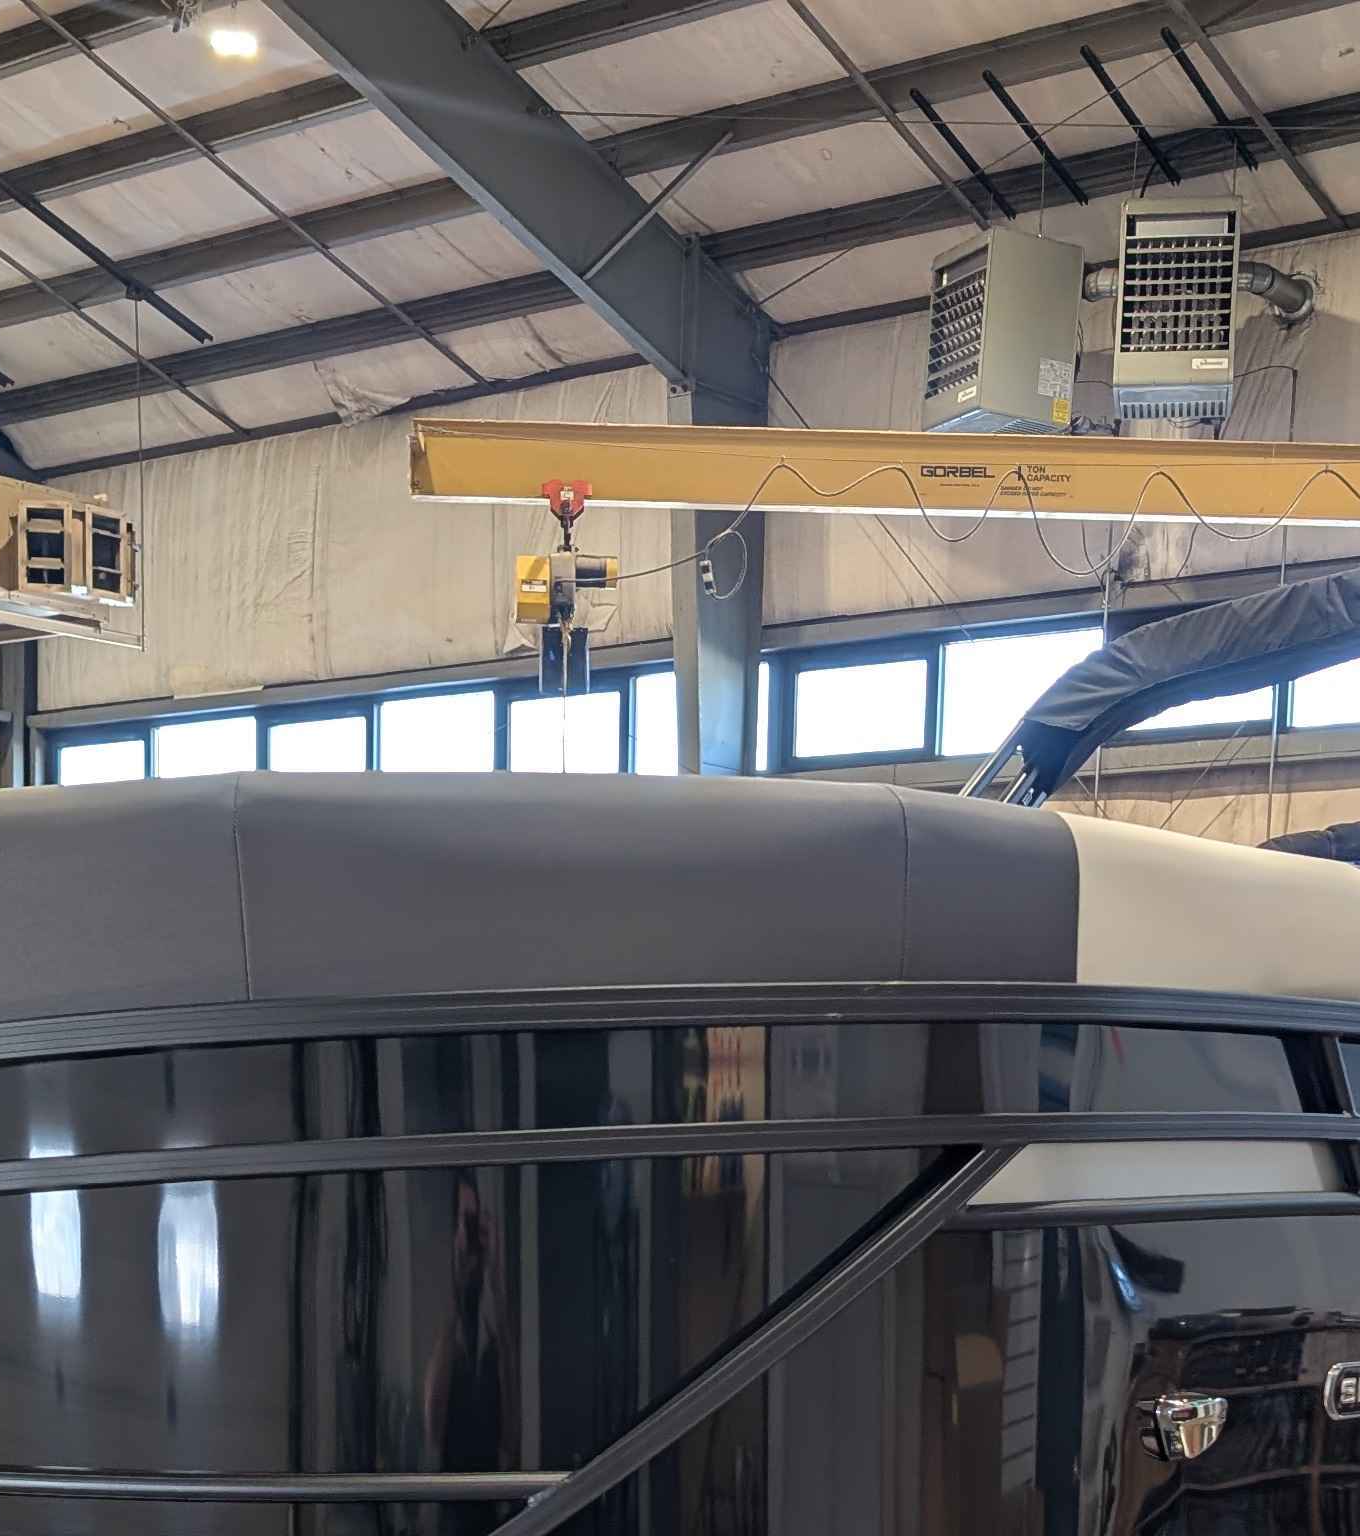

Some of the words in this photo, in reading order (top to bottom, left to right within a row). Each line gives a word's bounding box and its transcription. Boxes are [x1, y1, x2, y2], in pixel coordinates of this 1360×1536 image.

[920, 465, 995, 479] GORBEL
[1026, 465, 1046, 474] TON
[1026, 474, 1072, 483] CAPACITY
